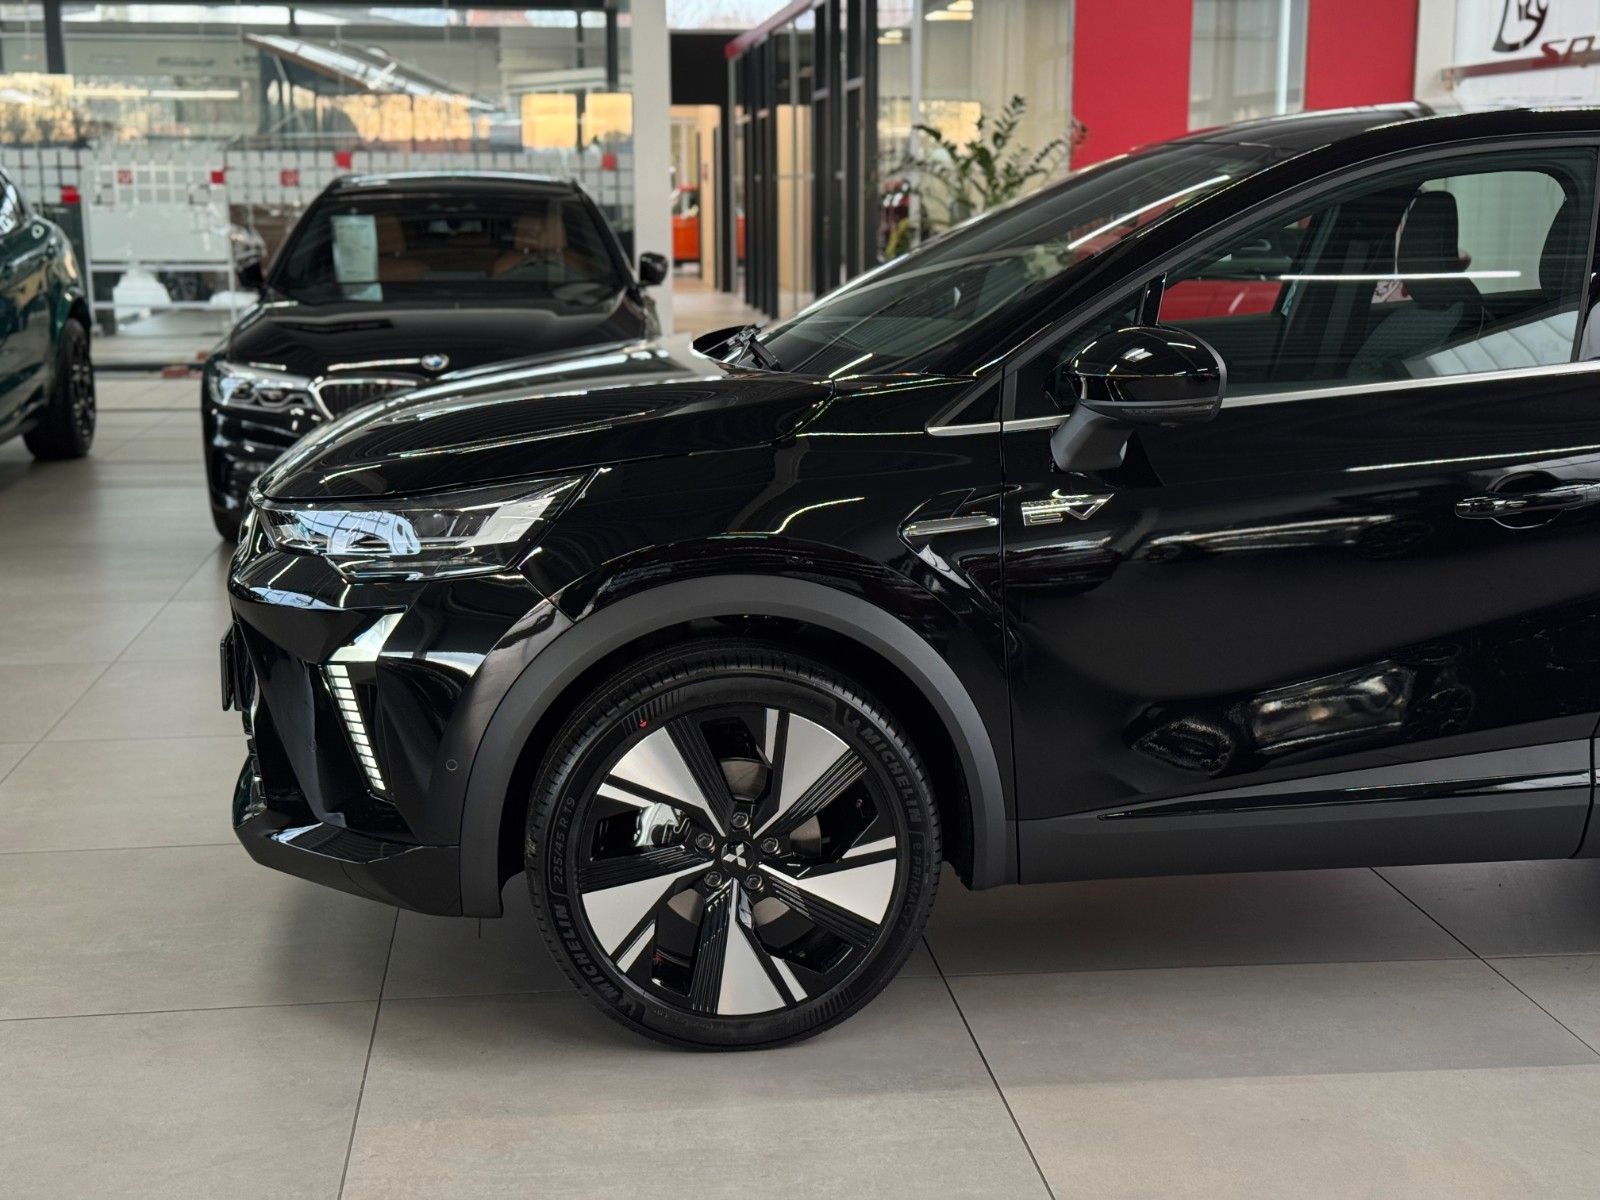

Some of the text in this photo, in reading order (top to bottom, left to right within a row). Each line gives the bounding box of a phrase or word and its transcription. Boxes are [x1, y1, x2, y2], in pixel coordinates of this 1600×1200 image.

[860, 727, 922, 823] MICHELIN
[553, 797, 576, 885] 225/45 R 19
[553, 903, 621, 999] MICHELIN
